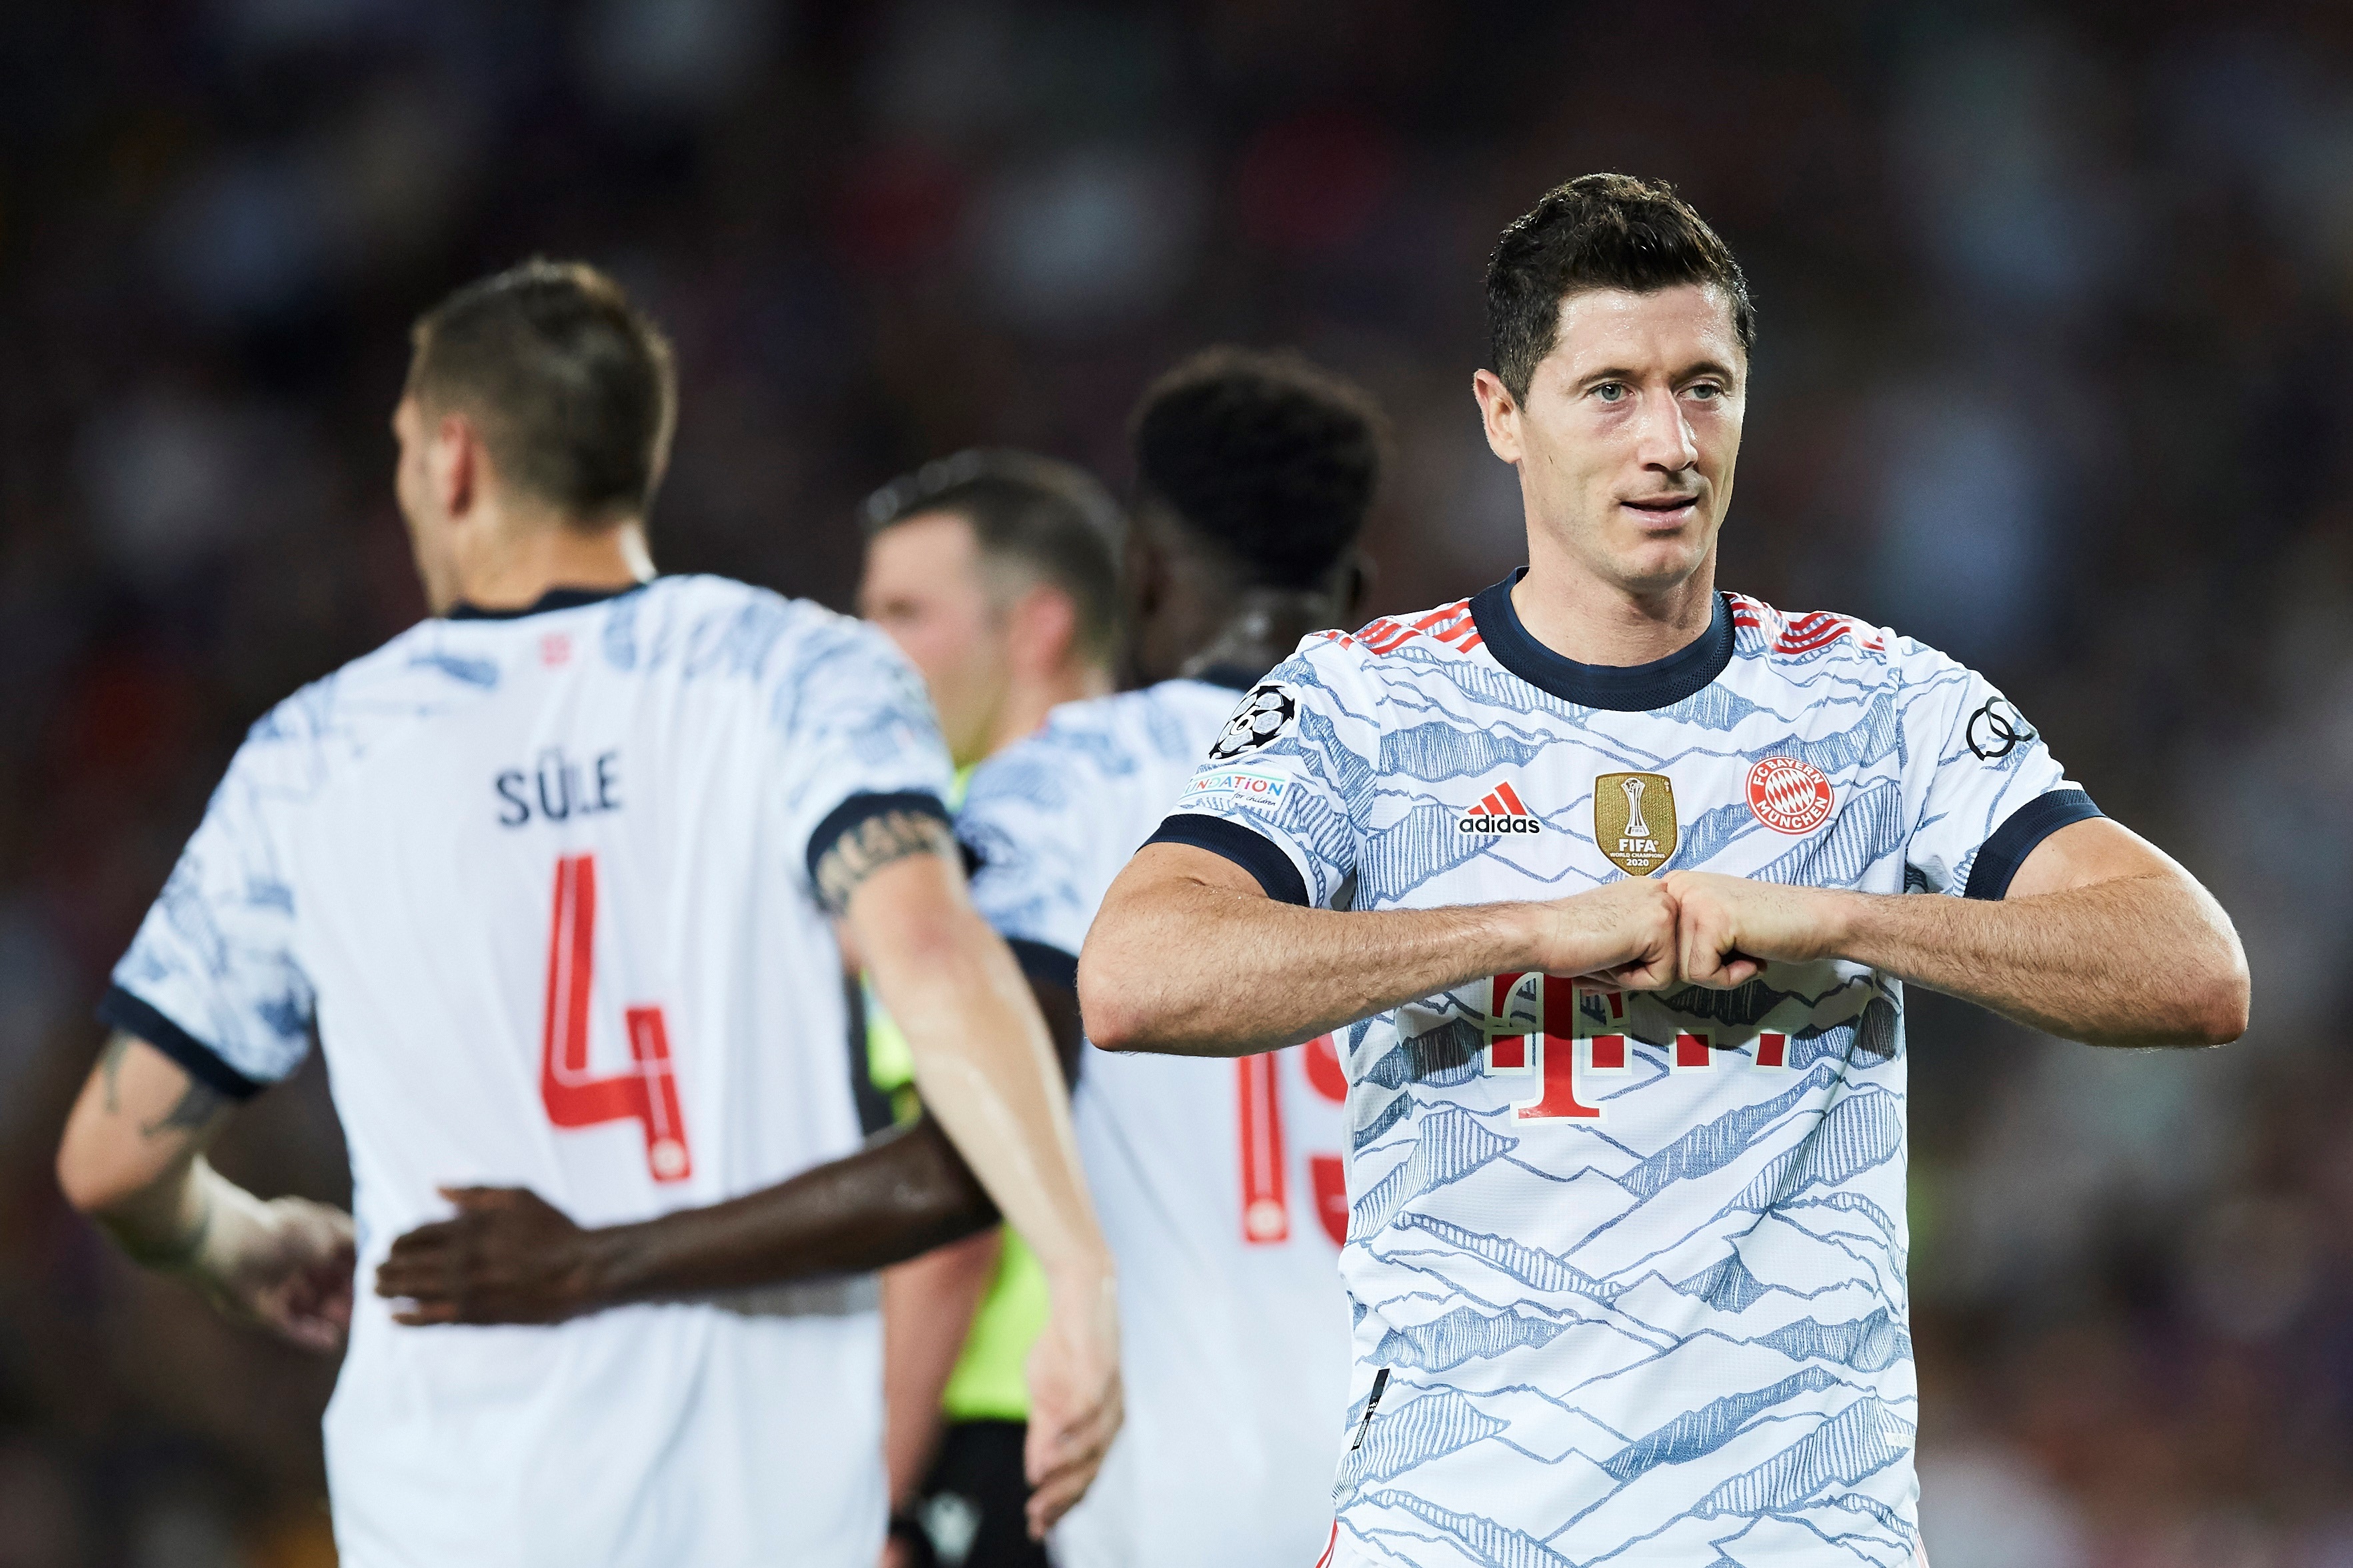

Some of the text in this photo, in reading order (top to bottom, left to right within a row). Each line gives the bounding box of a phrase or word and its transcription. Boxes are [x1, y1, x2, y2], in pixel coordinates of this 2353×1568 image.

[1752, 759, 1824, 786] FC BAYERN
[496, 746, 623, 828] SÜLE
[1231, 791, 1276, 806] for children
[1459, 814, 1540, 834] adidas
[1618, 838, 1657, 853] FIFA
[542, 854, 692, 1183] 4
